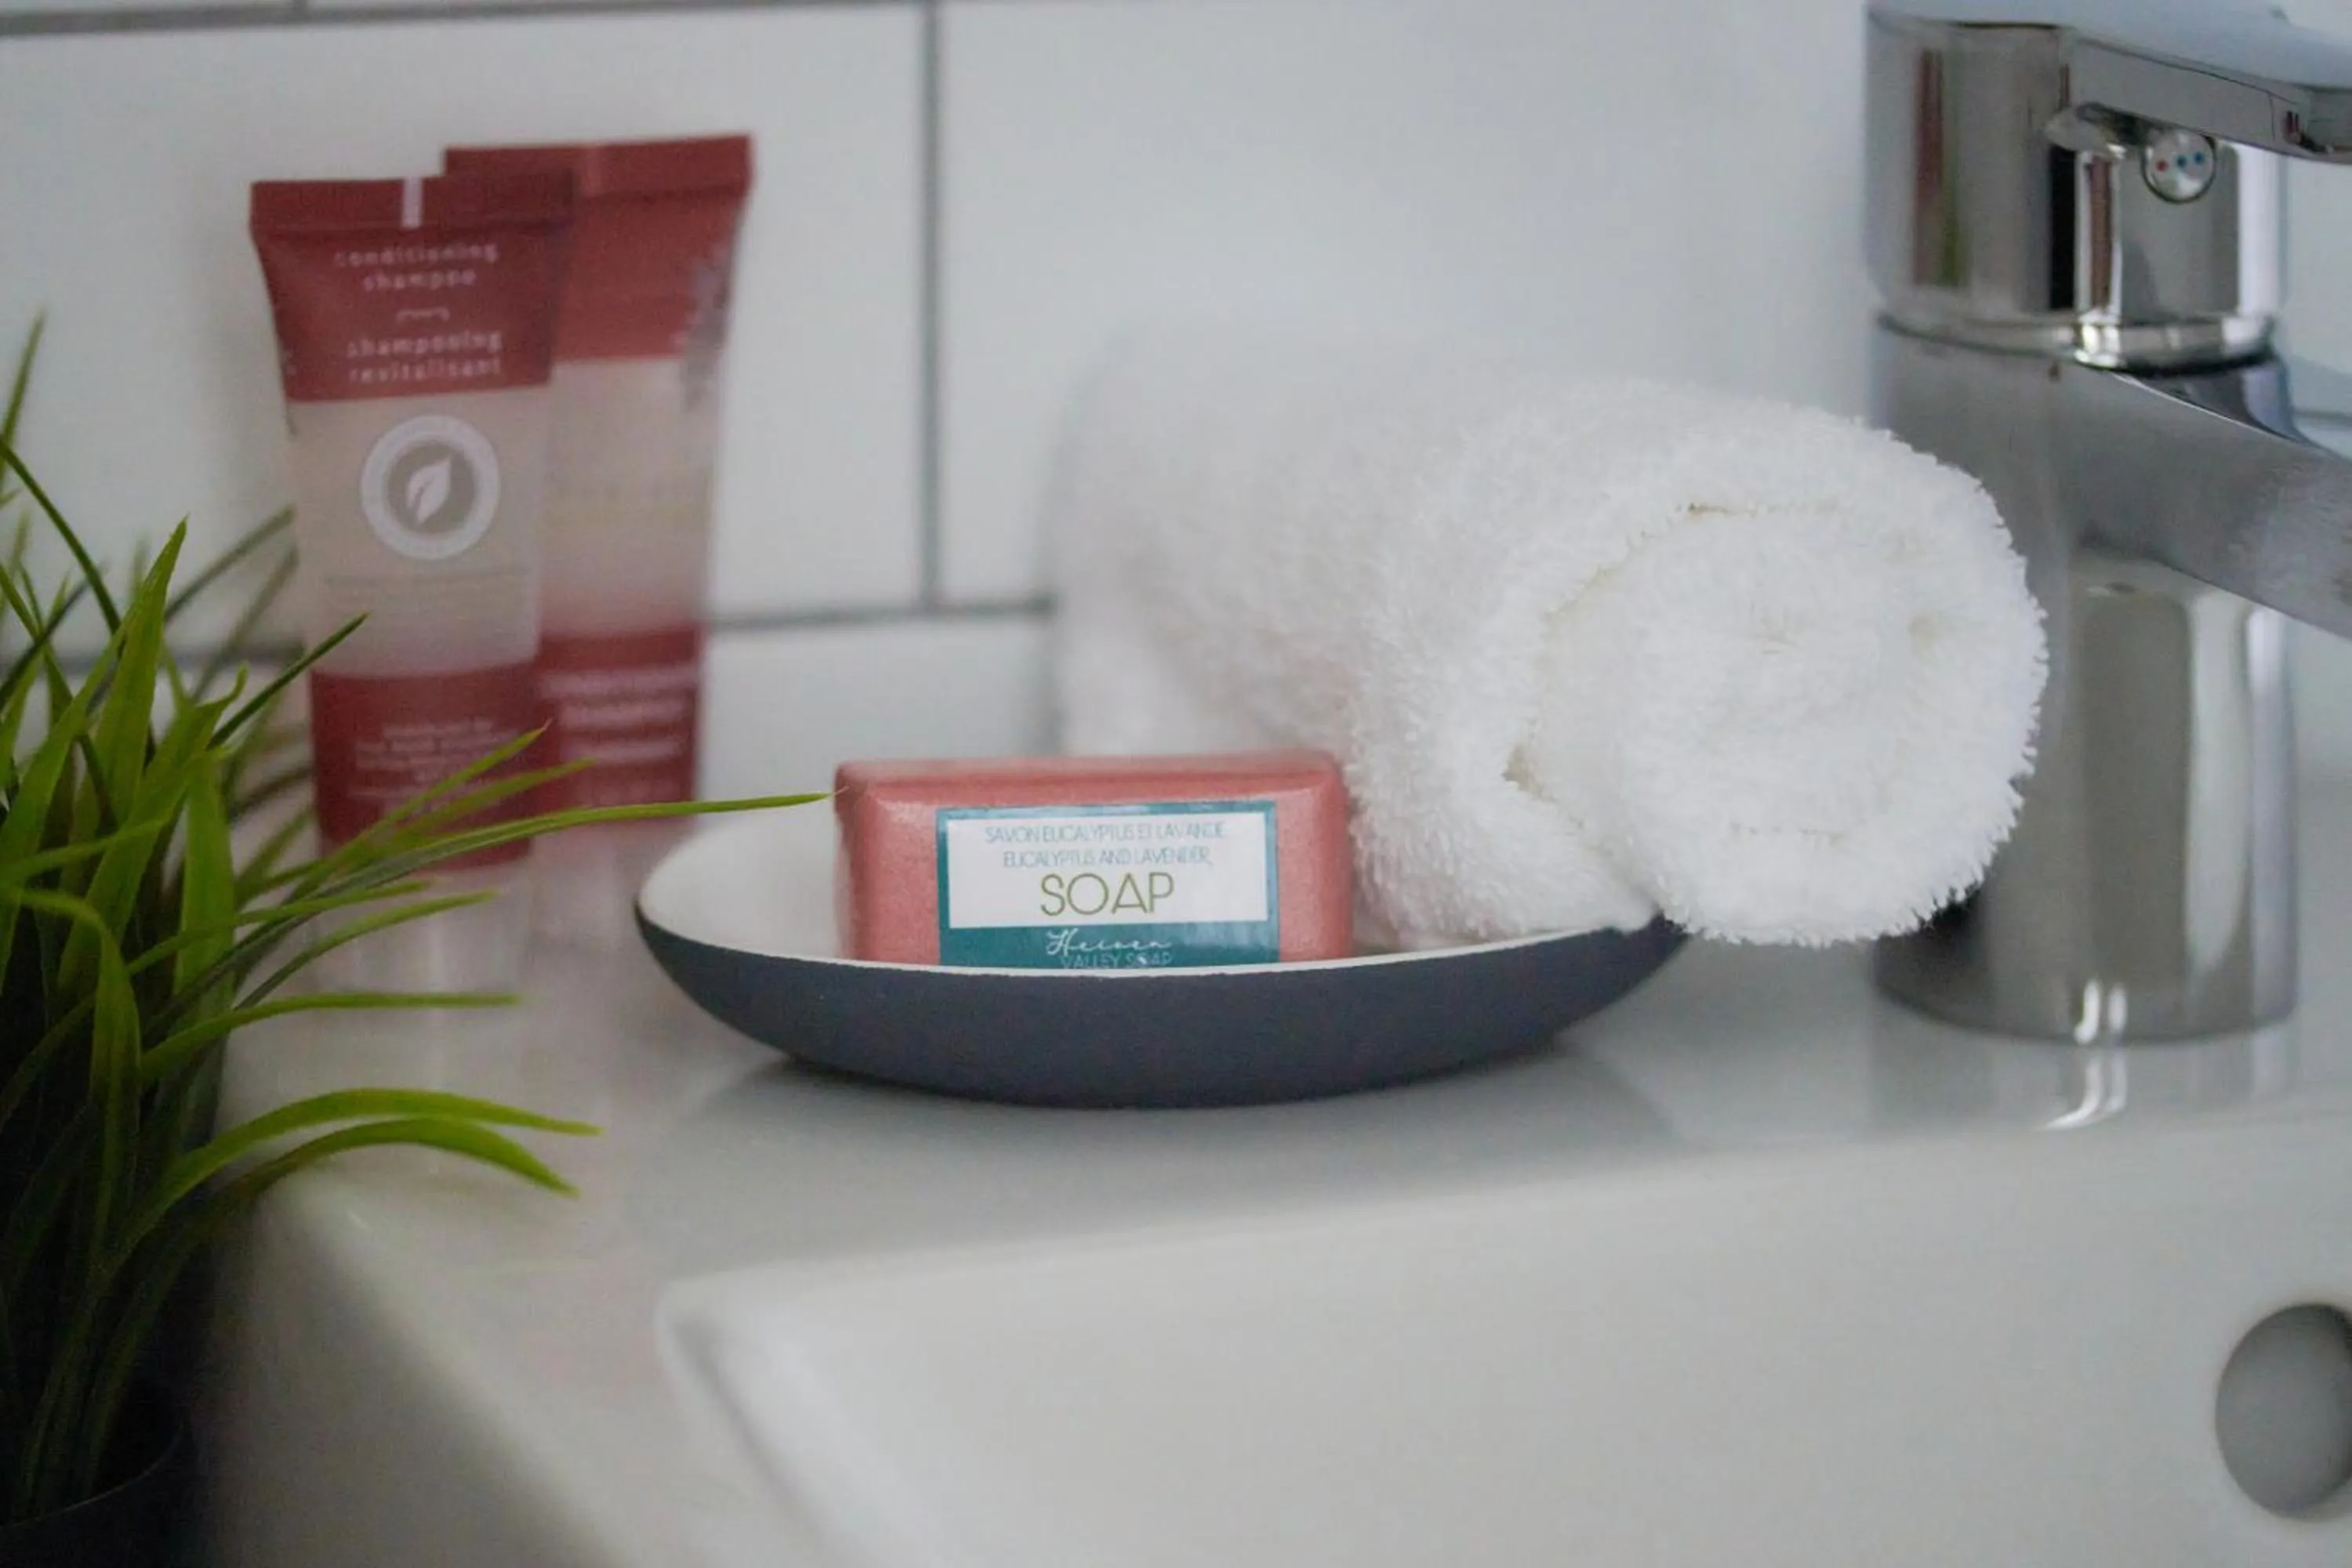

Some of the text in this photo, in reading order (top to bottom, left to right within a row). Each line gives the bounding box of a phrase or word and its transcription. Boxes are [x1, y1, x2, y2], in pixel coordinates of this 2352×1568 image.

[985, 826, 1040, 844] SAVON
[1042, 823, 1135, 844] EUCALYPTUS
[1156, 822, 1225, 840] LAVANDE
[1003, 848, 1097, 869] EUCALYPTUS
[1099, 847, 1132, 866] AND
[1040, 872, 1175, 916] SOAP
[1060, 952, 1122, 969] VALLEY
